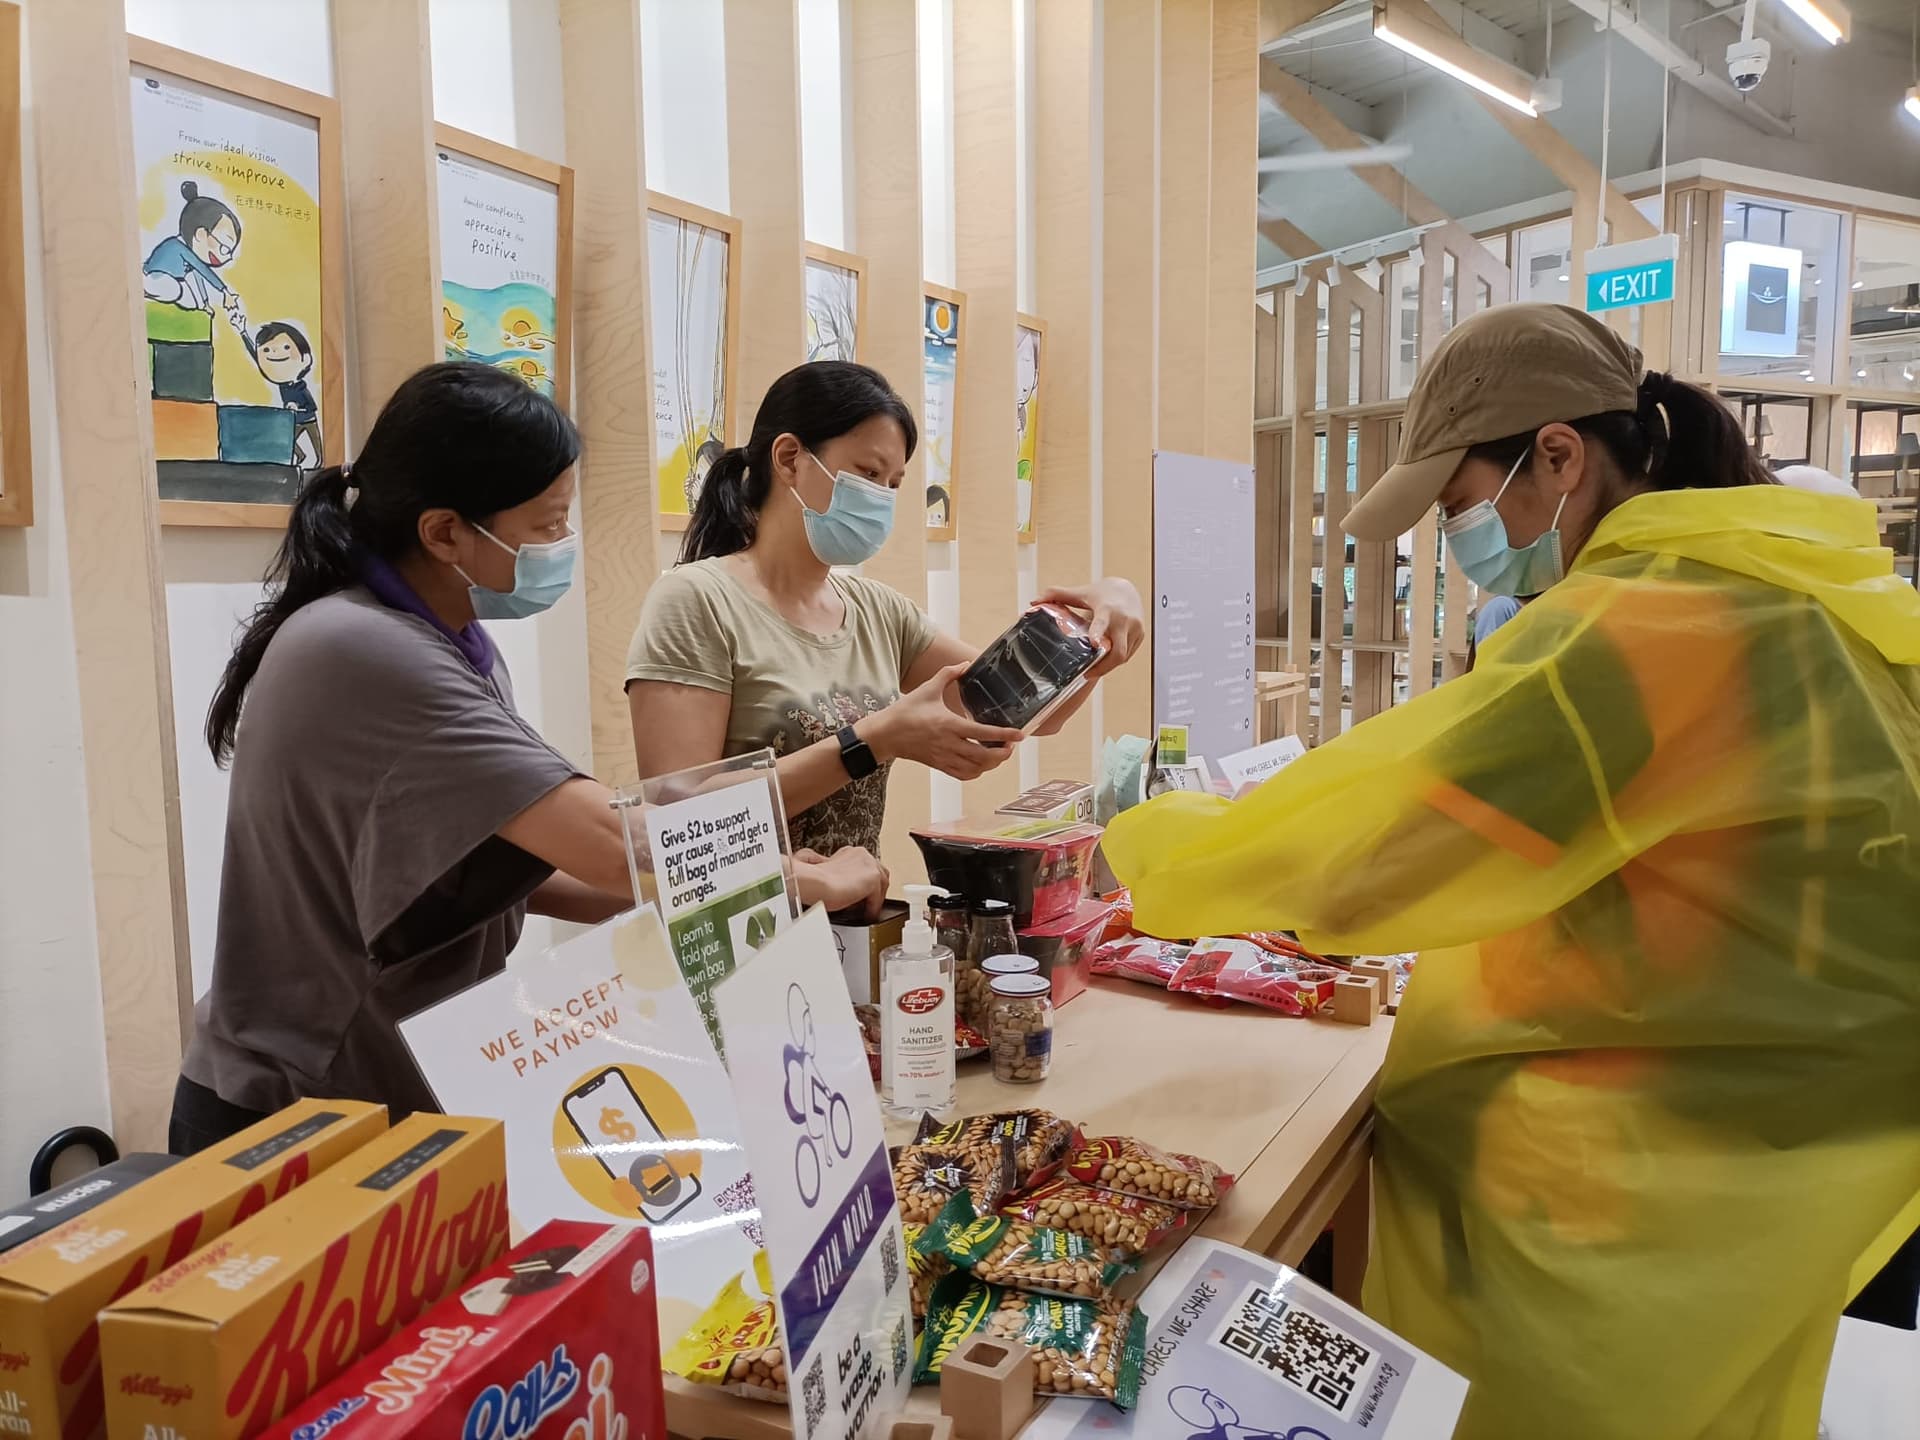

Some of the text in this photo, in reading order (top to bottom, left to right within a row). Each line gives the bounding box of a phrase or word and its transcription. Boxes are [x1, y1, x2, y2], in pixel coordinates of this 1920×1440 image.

[178, 130, 201, 145] From
[220, 138, 244, 156] ideal
[173, 151, 212, 171] strive
[226, 157, 286, 189] improve
[464, 217, 511, 240] appreciate
[1611, 268, 1662, 303] EXIT
[661, 806, 751, 848] Give $2 to support
[665, 821, 769, 868] our cause and get a
[668, 839, 764, 889] full bag of mandarin
[672, 881, 717, 907] oranges.
[677, 920, 715, 947] Learn to
[681, 939, 721, 968] fold your
[686, 957, 725, 988] own bag
[901, 994, 942, 1006] Lifebuoy
[480, 973, 625, 1063] WE ACCEPT
[909, 1026, 934, 1035] HAND
[513, 1006, 620, 1078] PAYNOW
[900, 1034, 944, 1045] SANITIZER
[909, 1071, 923, 1079] 70%
[813, 1184, 874, 1308] JOIN MONO
[1140, 1281, 1218, 1377] CARES, WE SHARE
[837, 1331, 861, 1385] be a
[120, 1373, 194, 1407] Kellogg's
[841, 1350, 872, 1416] waste
[1356, 1361, 1402, 1430] www.mono.sg
